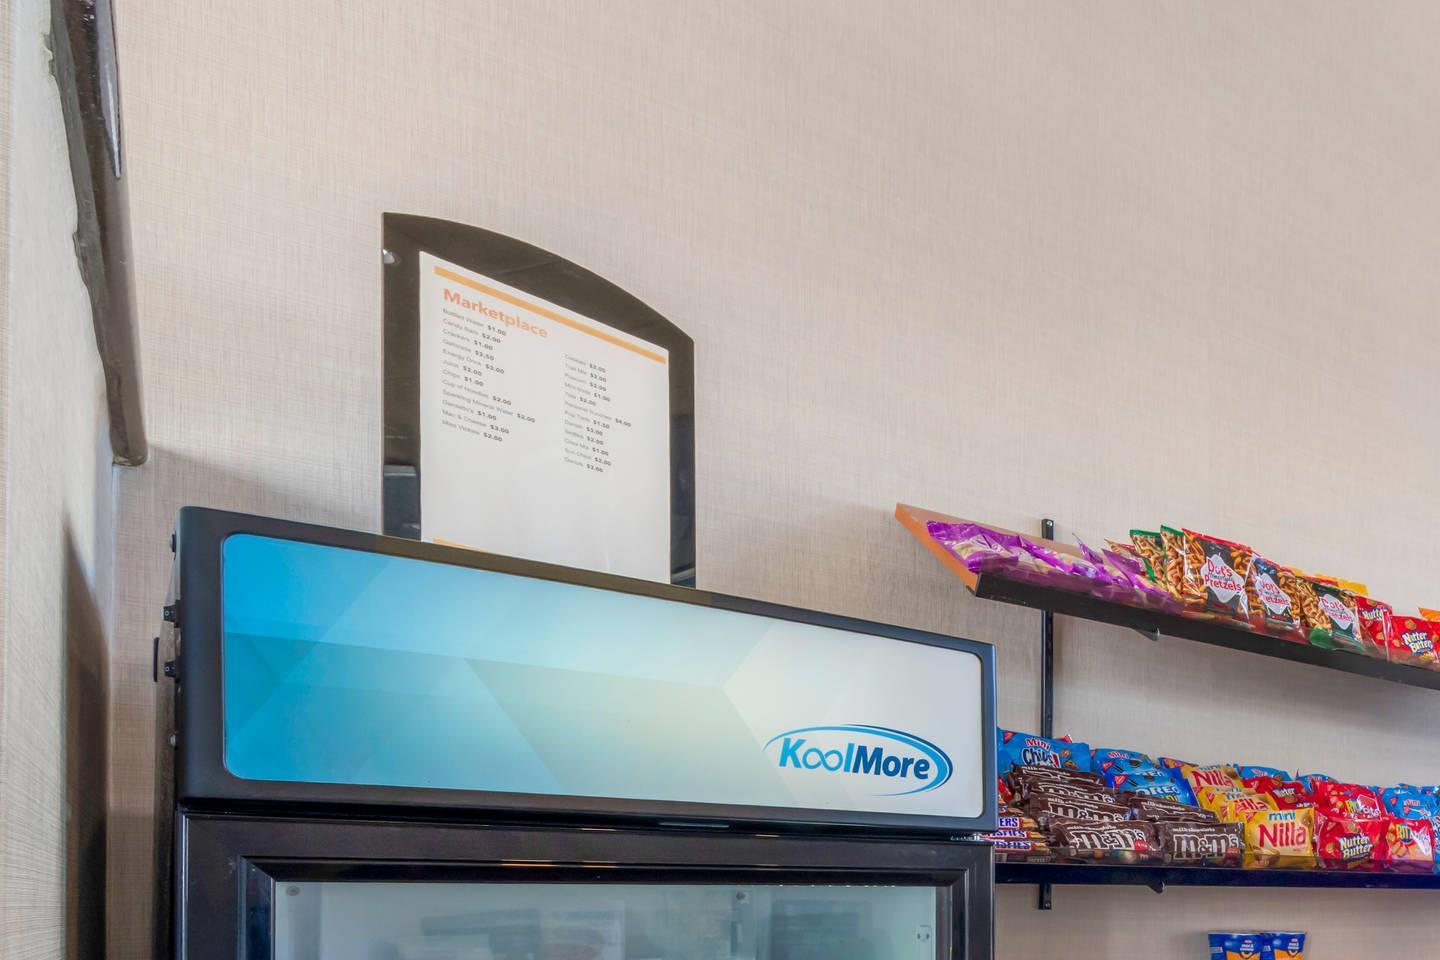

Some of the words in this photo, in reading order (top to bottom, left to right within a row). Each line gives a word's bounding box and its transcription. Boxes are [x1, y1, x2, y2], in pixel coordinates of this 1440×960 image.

[442, 287, 549, 338] Marketplace
[1206, 559, 1235, 578] Dot's
[1204, 574, 1243, 593] Pretzels
[1361, 608, 1388, 621] Nutte
[1401, 631, 1429, 646] Nutter
[1410, 641, 1434, 655] Butter
[1024, 737, 1052, 752] Mini
[778, 737, 931, 780] KoolMore
[1192, 767, 1237, 789] Nilla
[1268, 810, 1297, 822] mini
[1066, 828, 1148, 850] m&m's
[1257, 821, 1307, 849] Nilla
[1338, 833, 1370, 850] Nutter
[1172, 832, 1241, 861] m&m's
[1343, 842, 1375, 862] Butter
